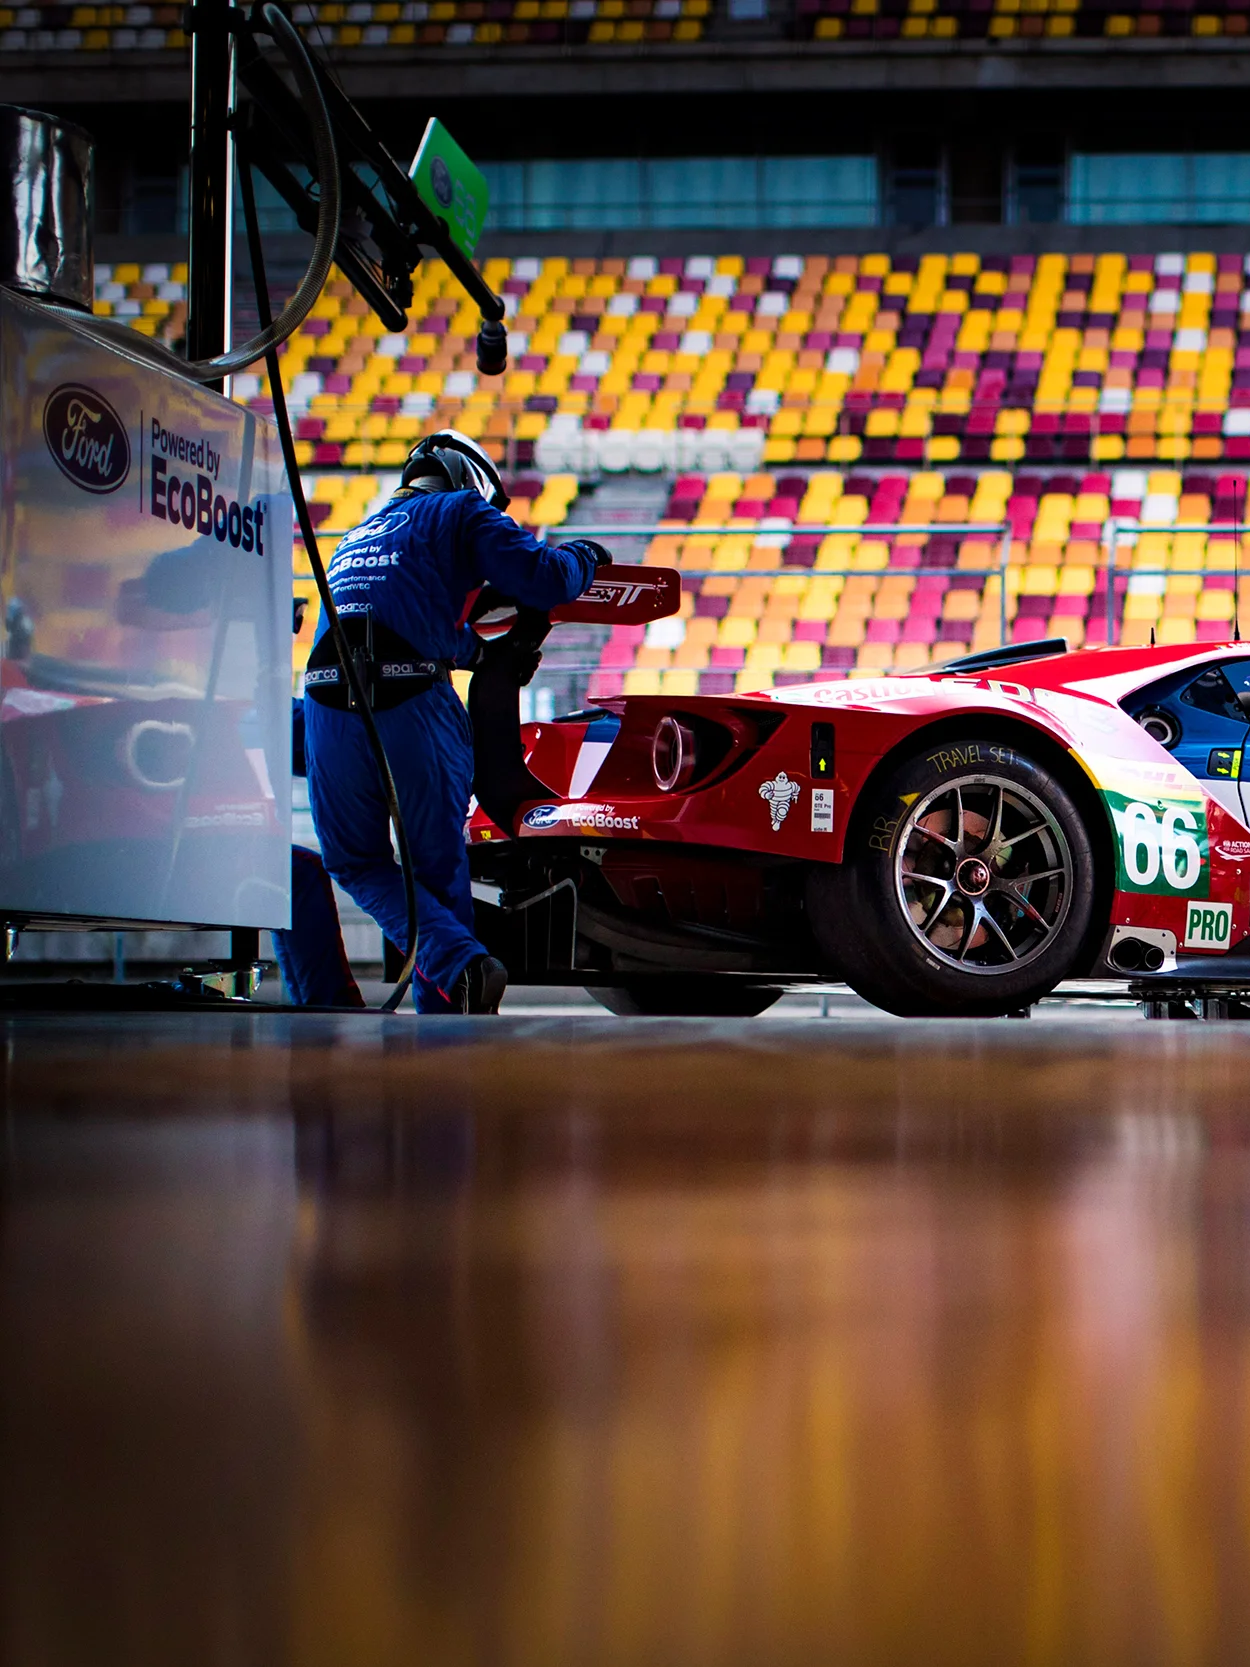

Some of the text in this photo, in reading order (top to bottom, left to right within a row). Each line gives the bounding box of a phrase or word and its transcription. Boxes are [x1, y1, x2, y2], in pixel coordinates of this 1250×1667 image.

[62, 398, 114, 477] Ford
[151, 417, 221, 481] Powered by
[151, 454, 264, 556] EcoBoost
[368, 545, 382, 554] by
[926, 744, 985, 774] TRAVEL
[528, 808, 553, 825] Ford
[572, 813, 638, 830] EcoBoost
[576, 804, 615, 813] Powered by
[1123, 802, 1200, 889] 66
[1188, 908, 1230, 942] PRO
